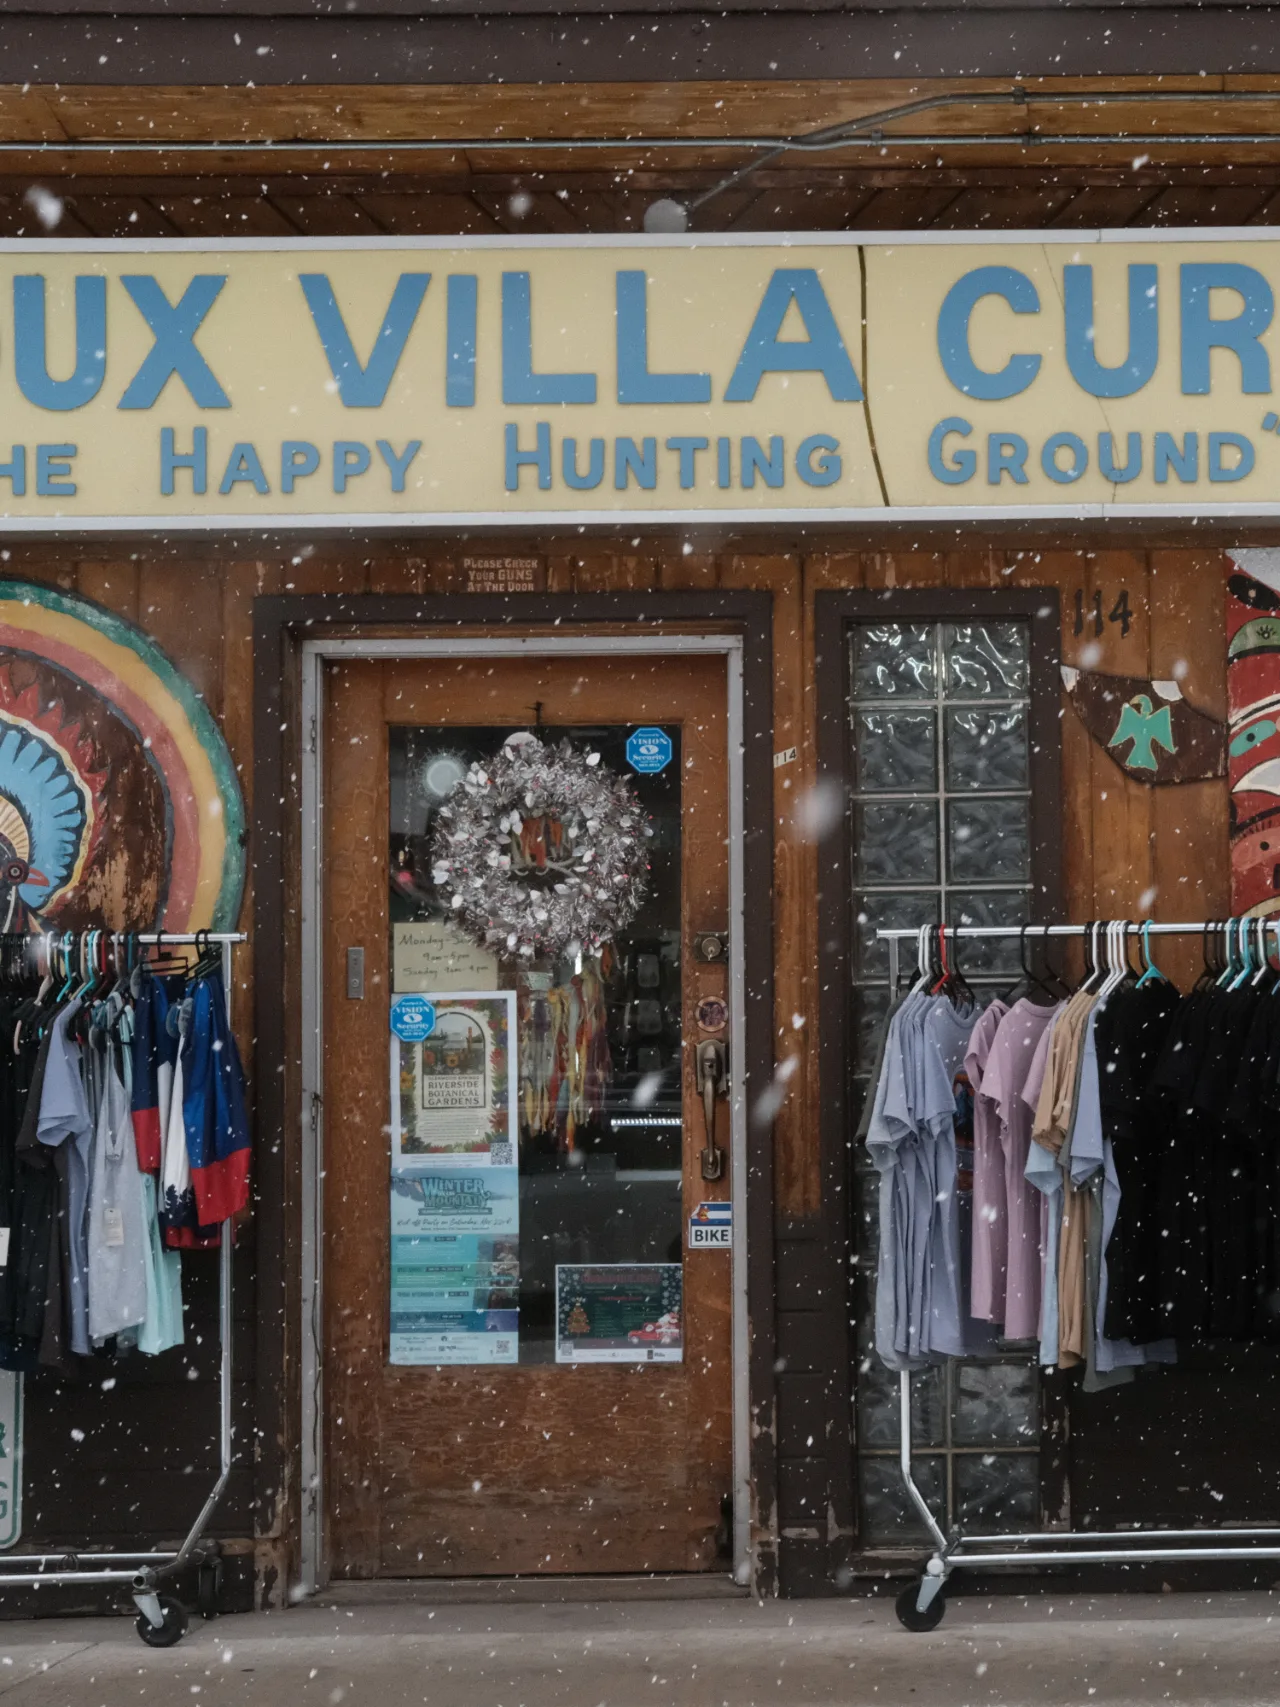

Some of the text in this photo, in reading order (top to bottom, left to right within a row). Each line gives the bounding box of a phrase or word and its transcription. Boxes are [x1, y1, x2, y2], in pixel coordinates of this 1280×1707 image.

[0, 274, 232, 411] UX
[298, 268, 868, 407] VILLA
[160, 426, 422, 495] HAPPY
[504, 421, 843, 490] HUNTING
[498, 569, 533, 580] GUNS
[483, 581, 504, 592] THE
[1074, 588, 1133, 640] 114
[632, 754, 665, 762] Security
[396, 1023, 429, 1031] Security
[428, 1080, 479, 1089] RIVERSIDE
[428, 1089, 480, 1097] BOTANICAL
[427, 1098, 480, 1106] GARDENS
[421, 1177, 485, 1196] WINTER
[694, 1229, 729, 1242] BIKE
